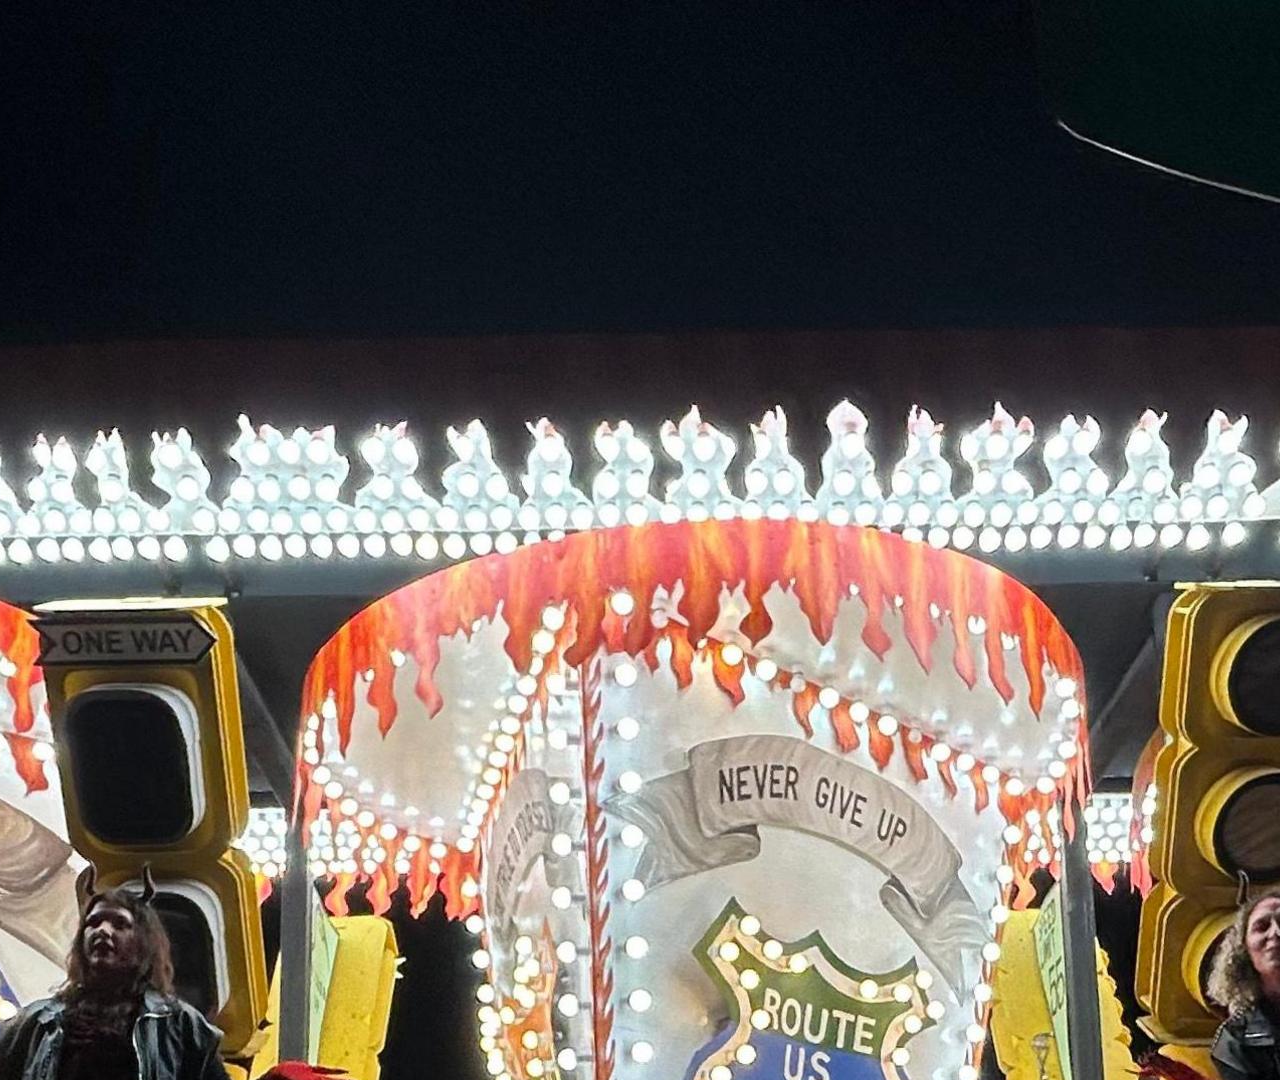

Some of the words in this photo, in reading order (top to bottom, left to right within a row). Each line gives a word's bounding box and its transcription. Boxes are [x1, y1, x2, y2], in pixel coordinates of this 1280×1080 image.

[62, 631, 122, 655] ONE
[131, 629, 194, 654] WAY
[719, 764, 799, 804] NEVER
[815, 776, 867, 828] GIVE
[877, 808, 907, 847] UP
[764, 987, 877, 1054] ROUTE
